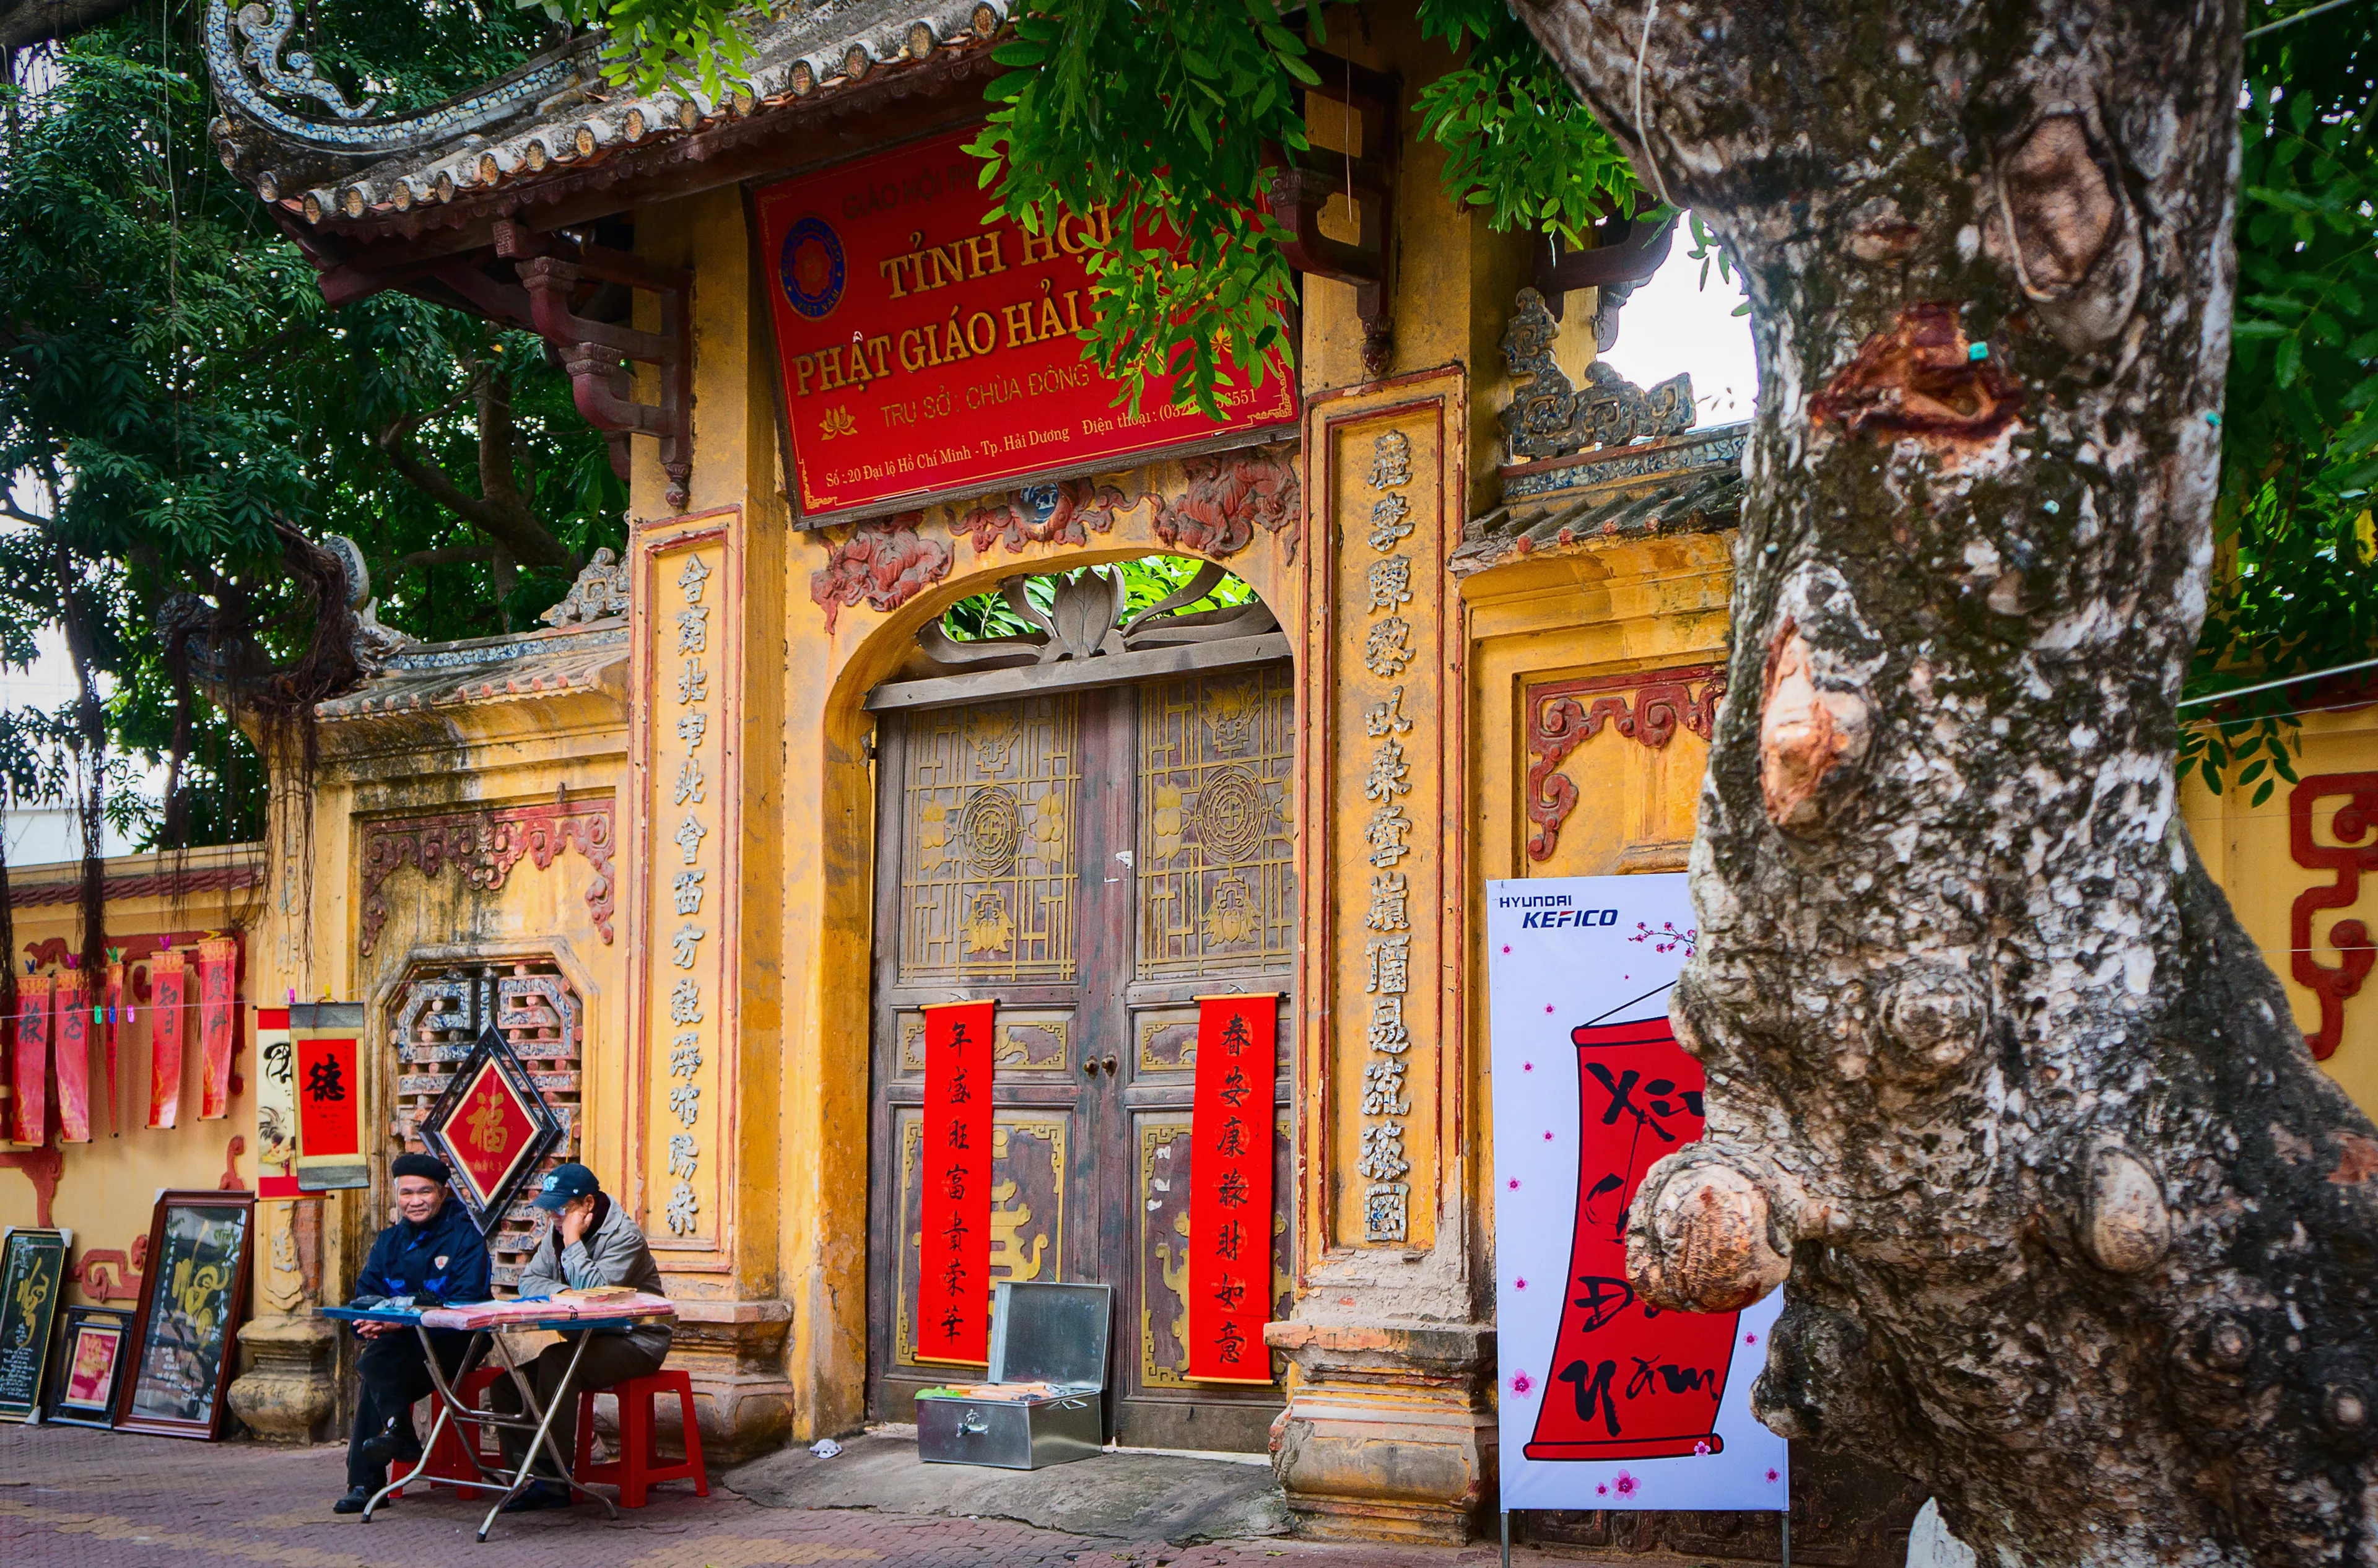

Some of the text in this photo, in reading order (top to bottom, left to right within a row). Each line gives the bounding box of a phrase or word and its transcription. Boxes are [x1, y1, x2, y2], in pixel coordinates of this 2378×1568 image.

[879, 231, 1008, 300] TỈNH
[792, 331, 892, 396] PHẬT
[899, 305, 996, 373] GIÁO
[1002, 278, 1082, 348] HẢI
[880, 401, 917, 427] TRỤ
[966, 374, 1022, 410] CHÙA
[1028, 364, 1091, 396] ĐÔNG
[863, 465, 884, 482] Đại
[886, 460, 896, 477] lộ
[897, 453, 915, 473] Hồ
[917, 448, 938, 469] Chí
[939, 445, 972, 464] Minh
[1003, 432, 1026, 451] Hải
[1029, 427, 1070, 445] Dương
[1082, 417, 1114, 436] Điện
[1499, 895, 1572, 908] HYUNDAI
[1522, 909, 1618, 929] KEFICO
